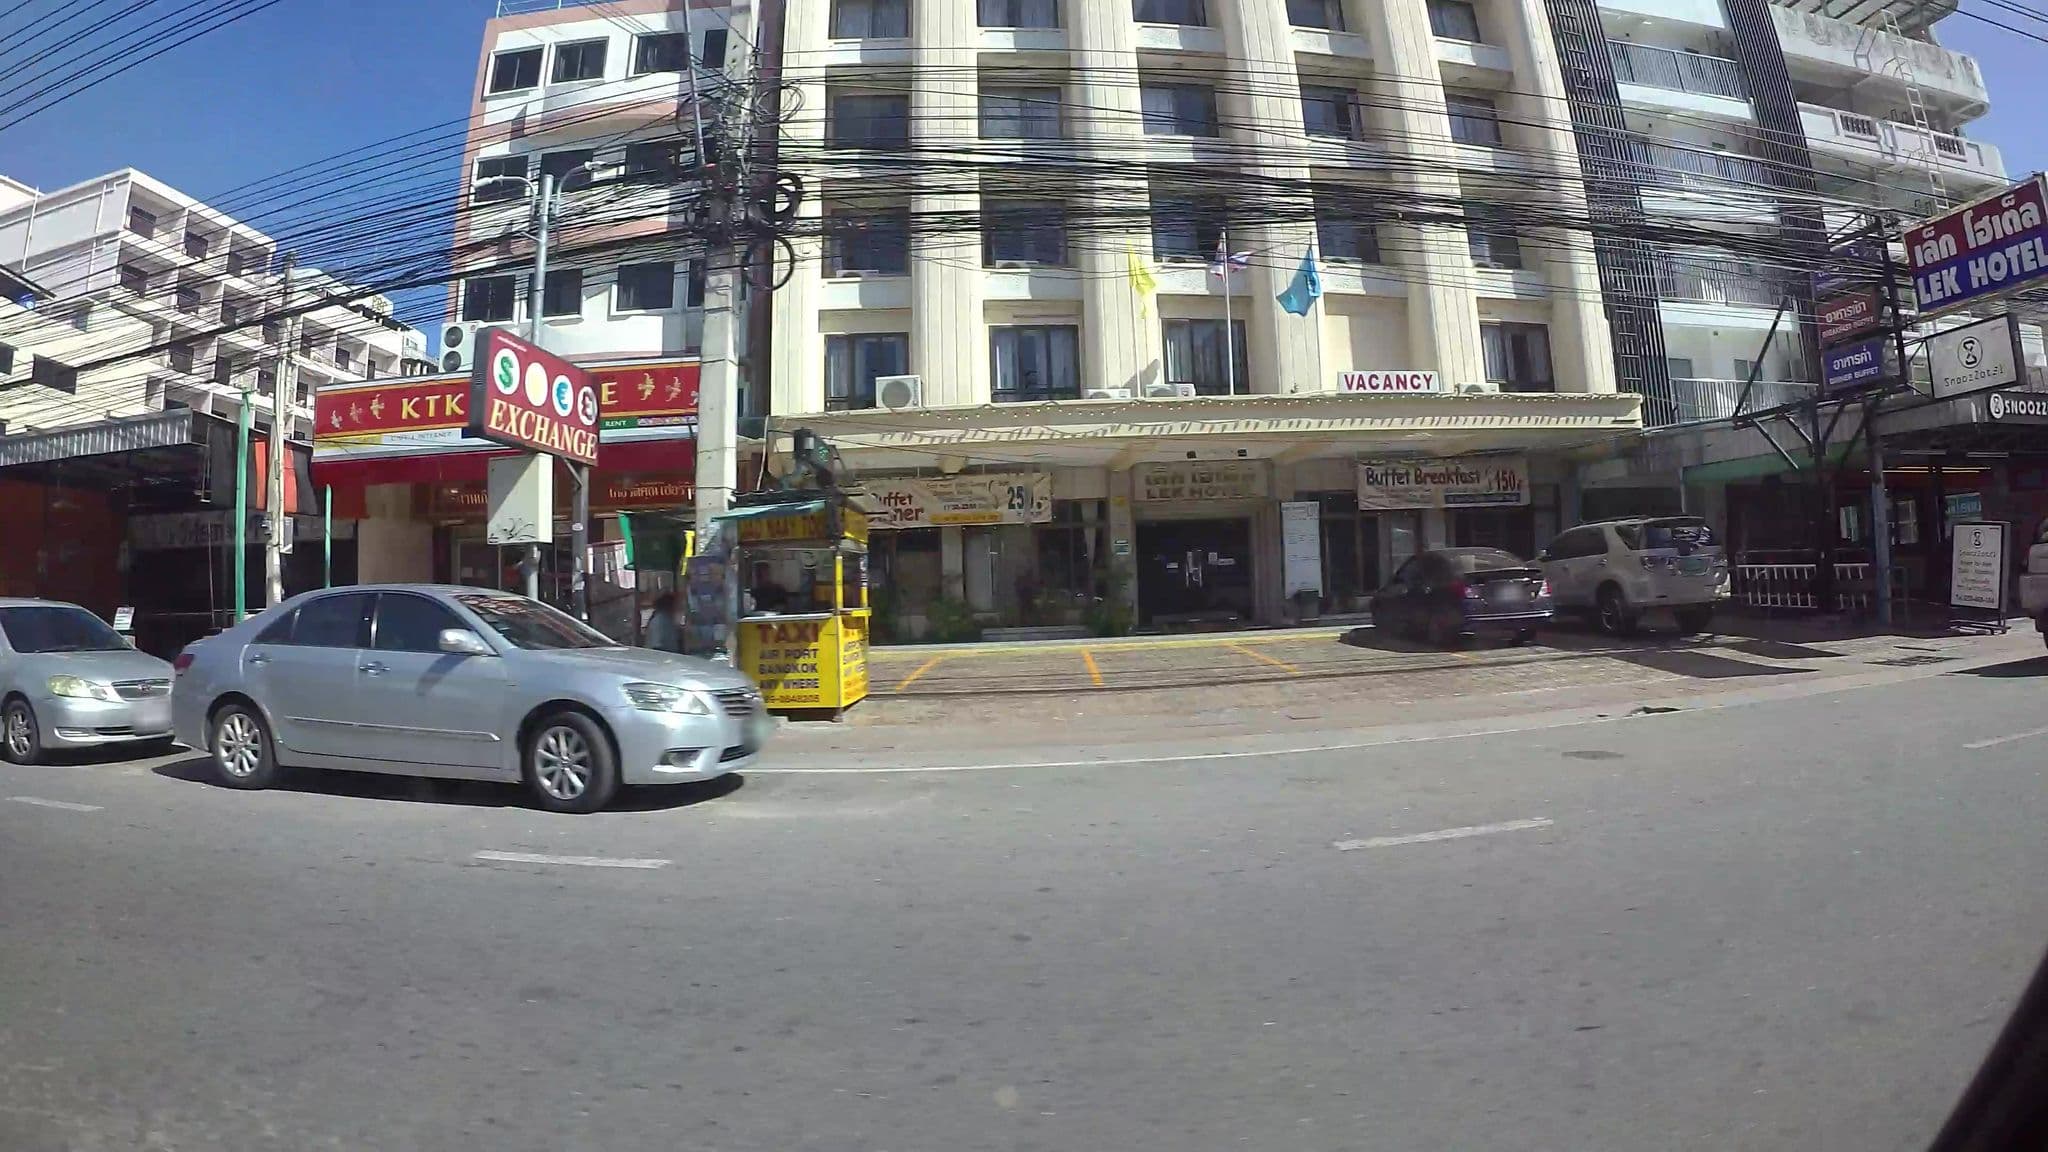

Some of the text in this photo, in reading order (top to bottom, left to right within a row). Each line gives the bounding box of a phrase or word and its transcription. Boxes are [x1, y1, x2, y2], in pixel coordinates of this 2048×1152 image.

[1914, 194, 2041, 267] เล็ก โฮเต็ล
[1917, 237, 2048, 304] LEK HOTEL
[1854, 366, 1879, 378] BUFFET
[1344, 374, 1433, 391] VACANCY
[401, 393, 465, 420] KTK
[2004, 400, 2048, 416] SNOOZZ
[488, 399, 598, 459] EXCHANGE
[1366, 466, 1410, 486] Buffet
[1414, 465, 1480, 486] Breakfast
[758, 622, 819, 643] TAXI
[784, 648, 819, 659] PORT
[759, 663, 819, 674] BANGKOK
[783, 679, 819, 689] WHERE
